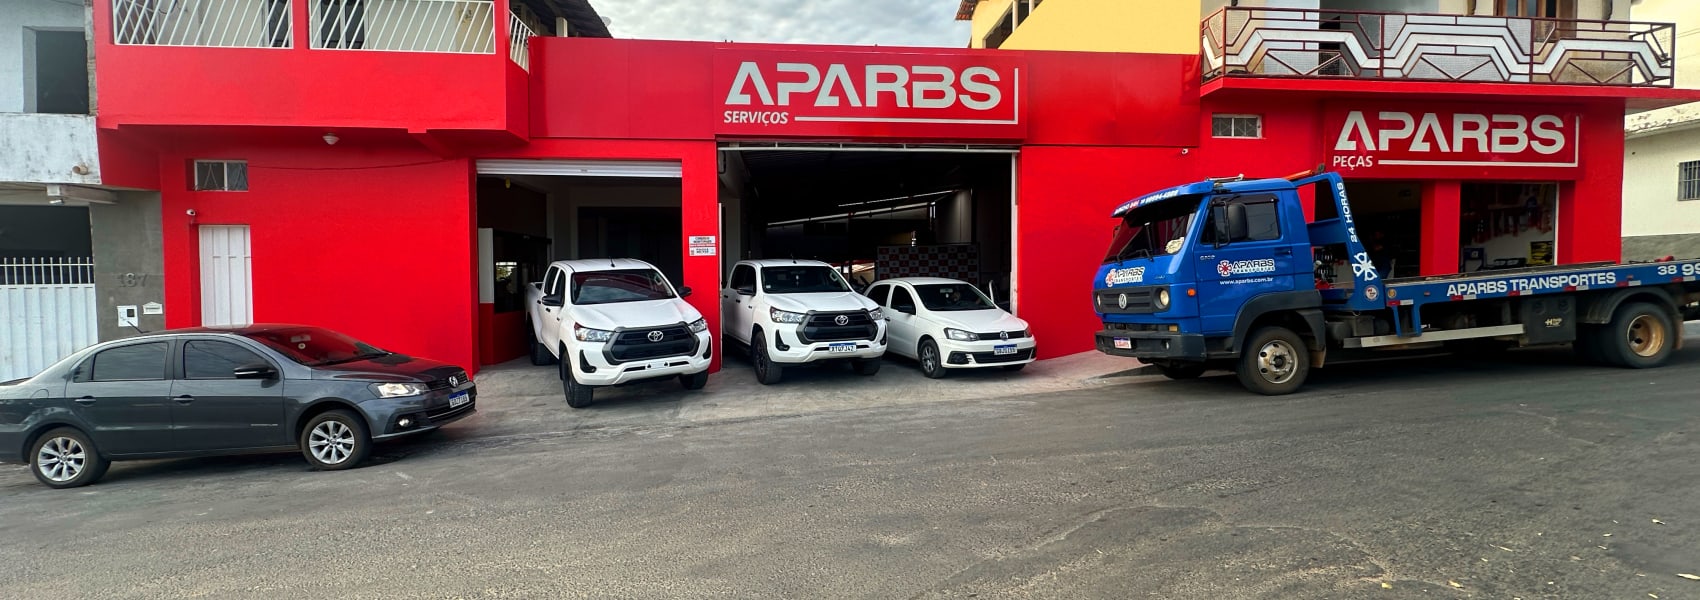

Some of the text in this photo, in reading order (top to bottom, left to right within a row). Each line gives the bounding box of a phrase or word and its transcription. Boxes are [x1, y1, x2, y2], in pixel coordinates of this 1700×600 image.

[724, 61, 1002, 110] APARBS
[723, 110, 789, 126] SERVIÇOS
[1334, 110, 1566, 155] APARBS
[1333, 155, 1374, 170] PEÇAS
[1336, 182, 1358, 243] 24 HORAS
[1231, 259, 1274, 269] APARBS
[1657, 264, 1678, 276] 38
[1220, 277, 1274, 285] www.aparbs.com.br
[1447, 272, 1617, 297] APARBS TRANSPORTES
